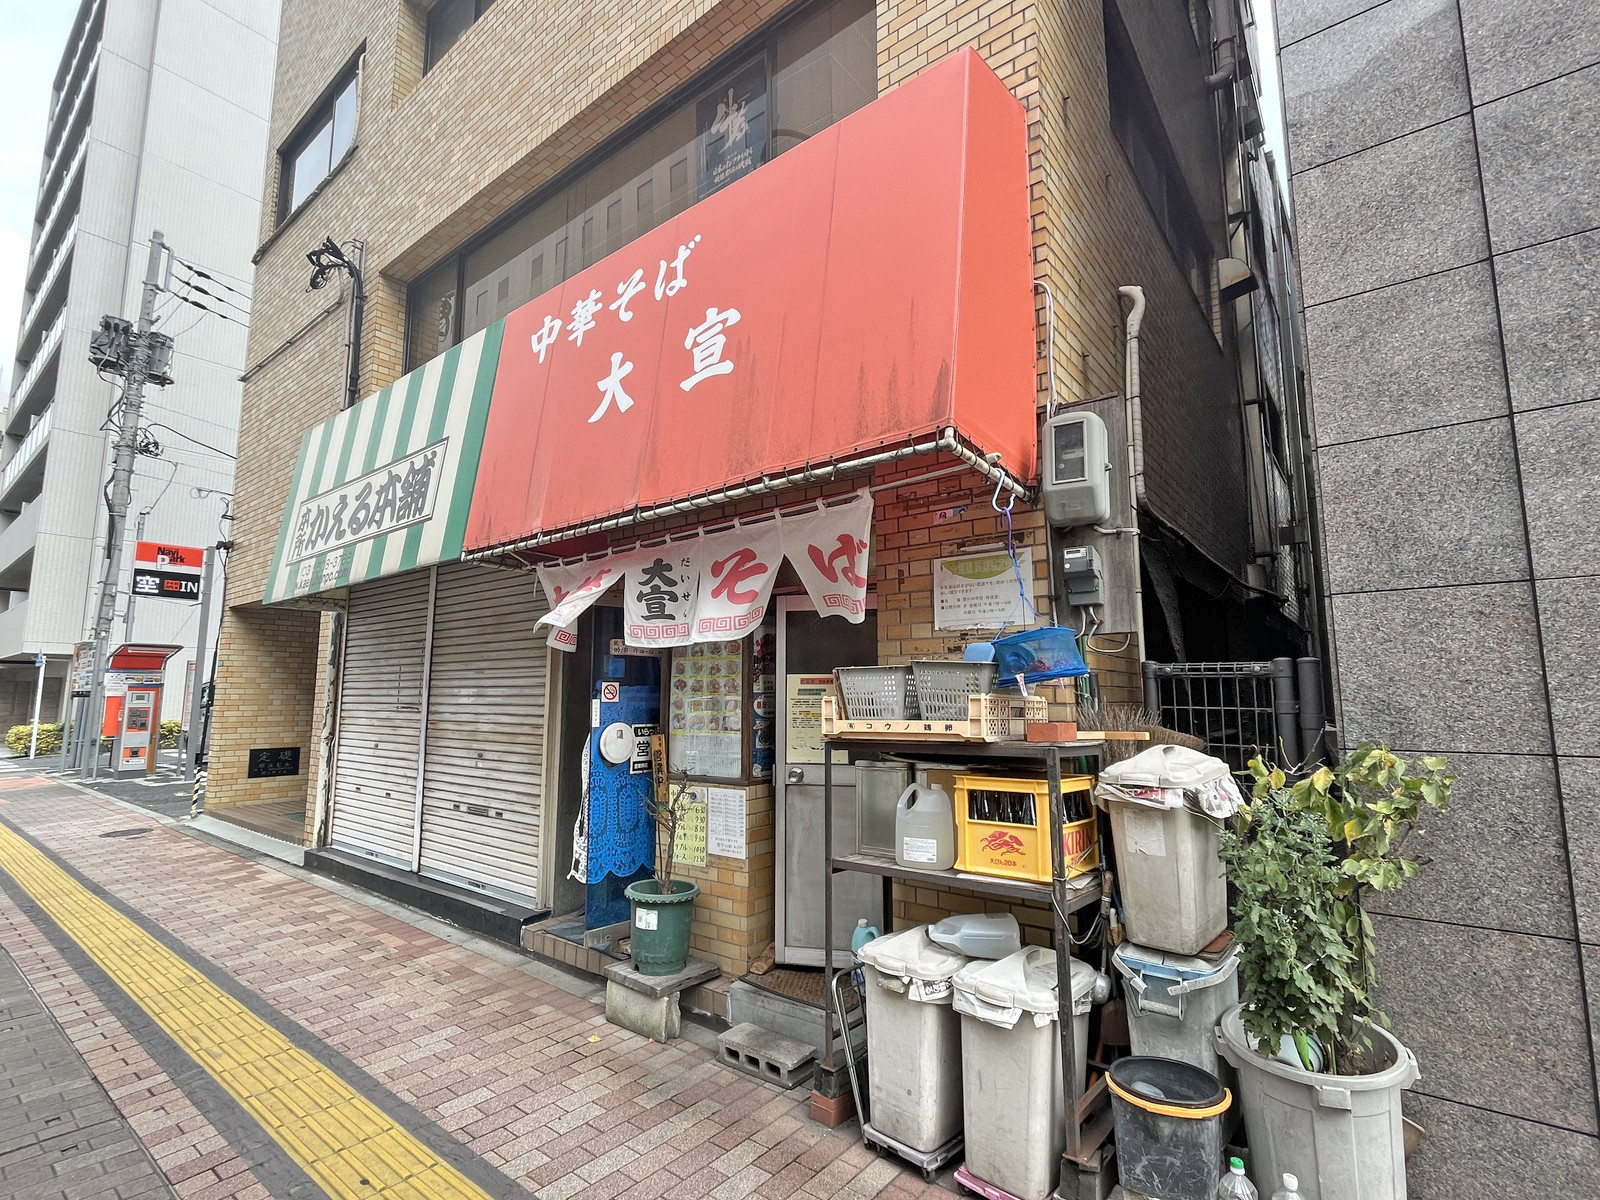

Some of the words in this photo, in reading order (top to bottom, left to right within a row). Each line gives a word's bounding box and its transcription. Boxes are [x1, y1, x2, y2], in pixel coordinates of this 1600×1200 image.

[530, 234, 703, 364] 中華そば
[587, 307, 742, 424] 大宣
[156, 554, 186, 570] Park
[157, 546, 179, 557] Navi
[711, 533, 868, 605] そば
[180, 581, 199, 593] IN
[636, 557, 679, 621] 大宣
[1063, 827, 1095, 857] KIRIN
